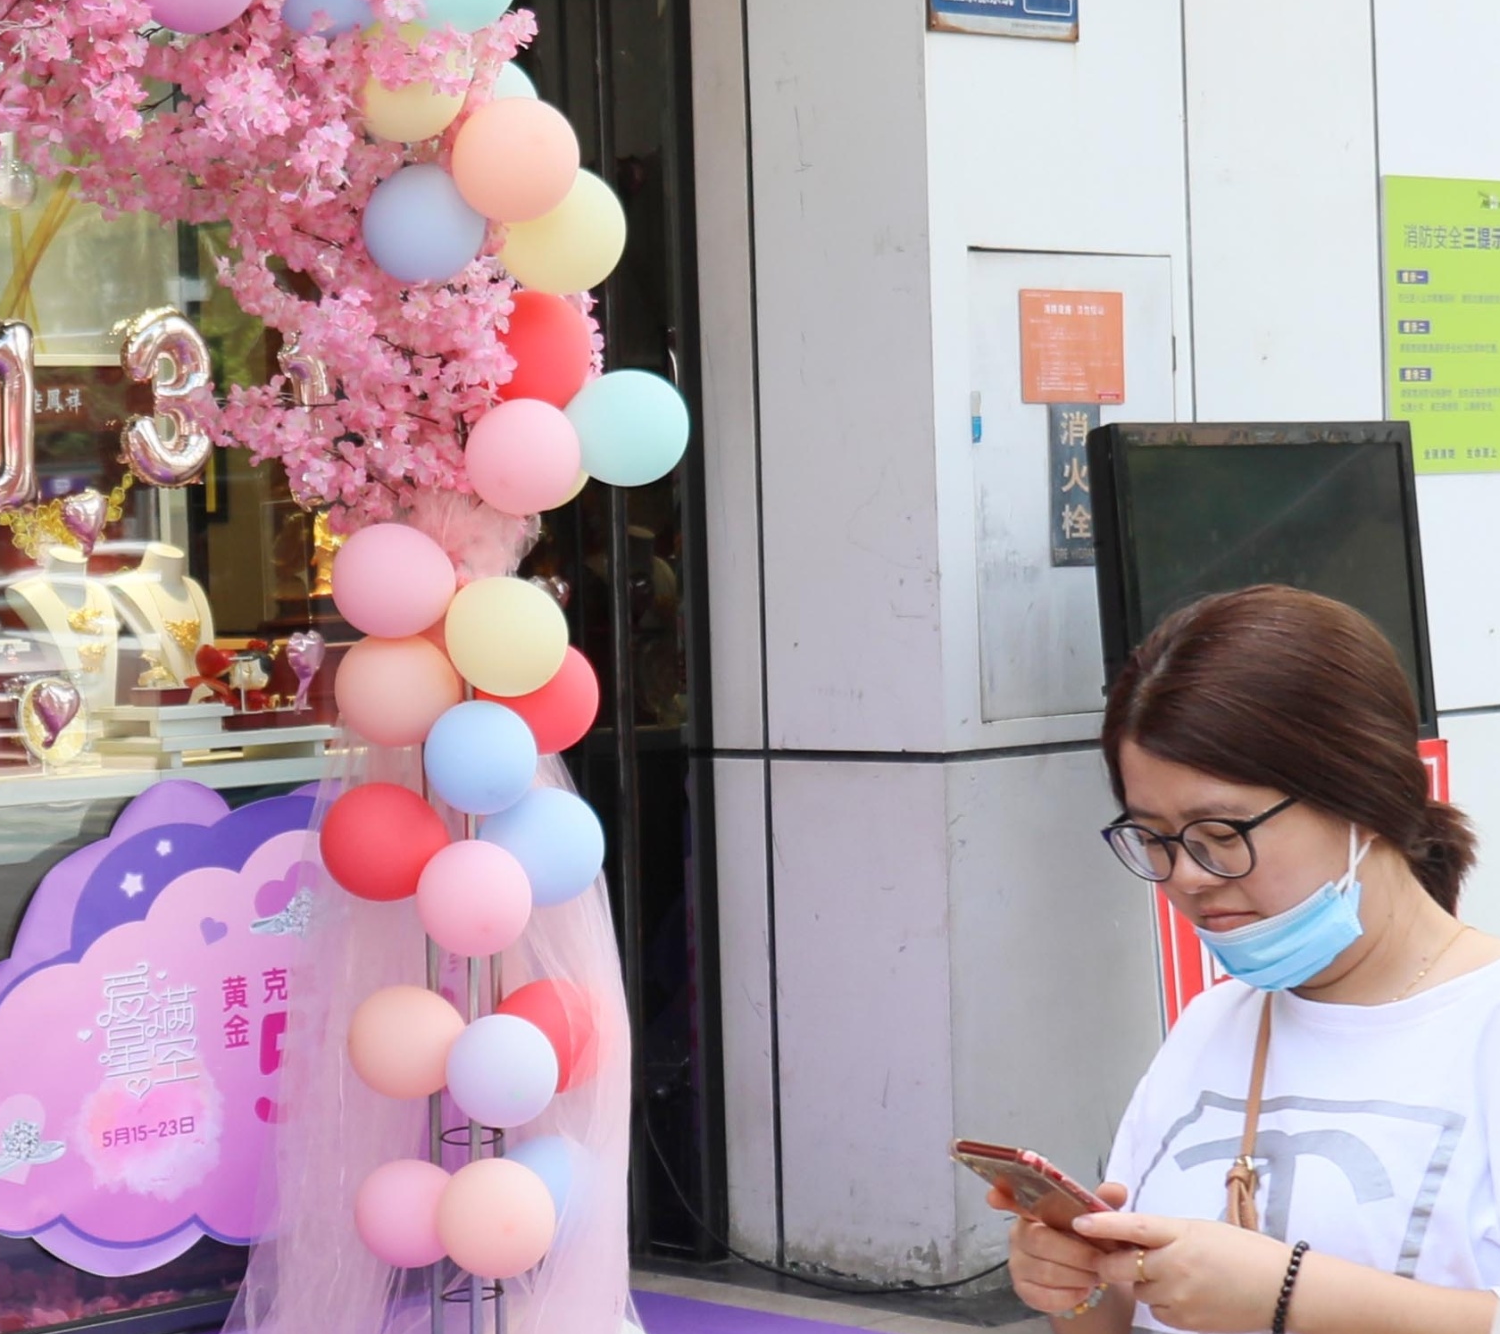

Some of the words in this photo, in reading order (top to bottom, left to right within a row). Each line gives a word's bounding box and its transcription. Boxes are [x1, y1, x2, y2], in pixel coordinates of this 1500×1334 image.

[1060, 411, 1093, 540] 消火栓
[221, 975, 251, 1050] 黄金
